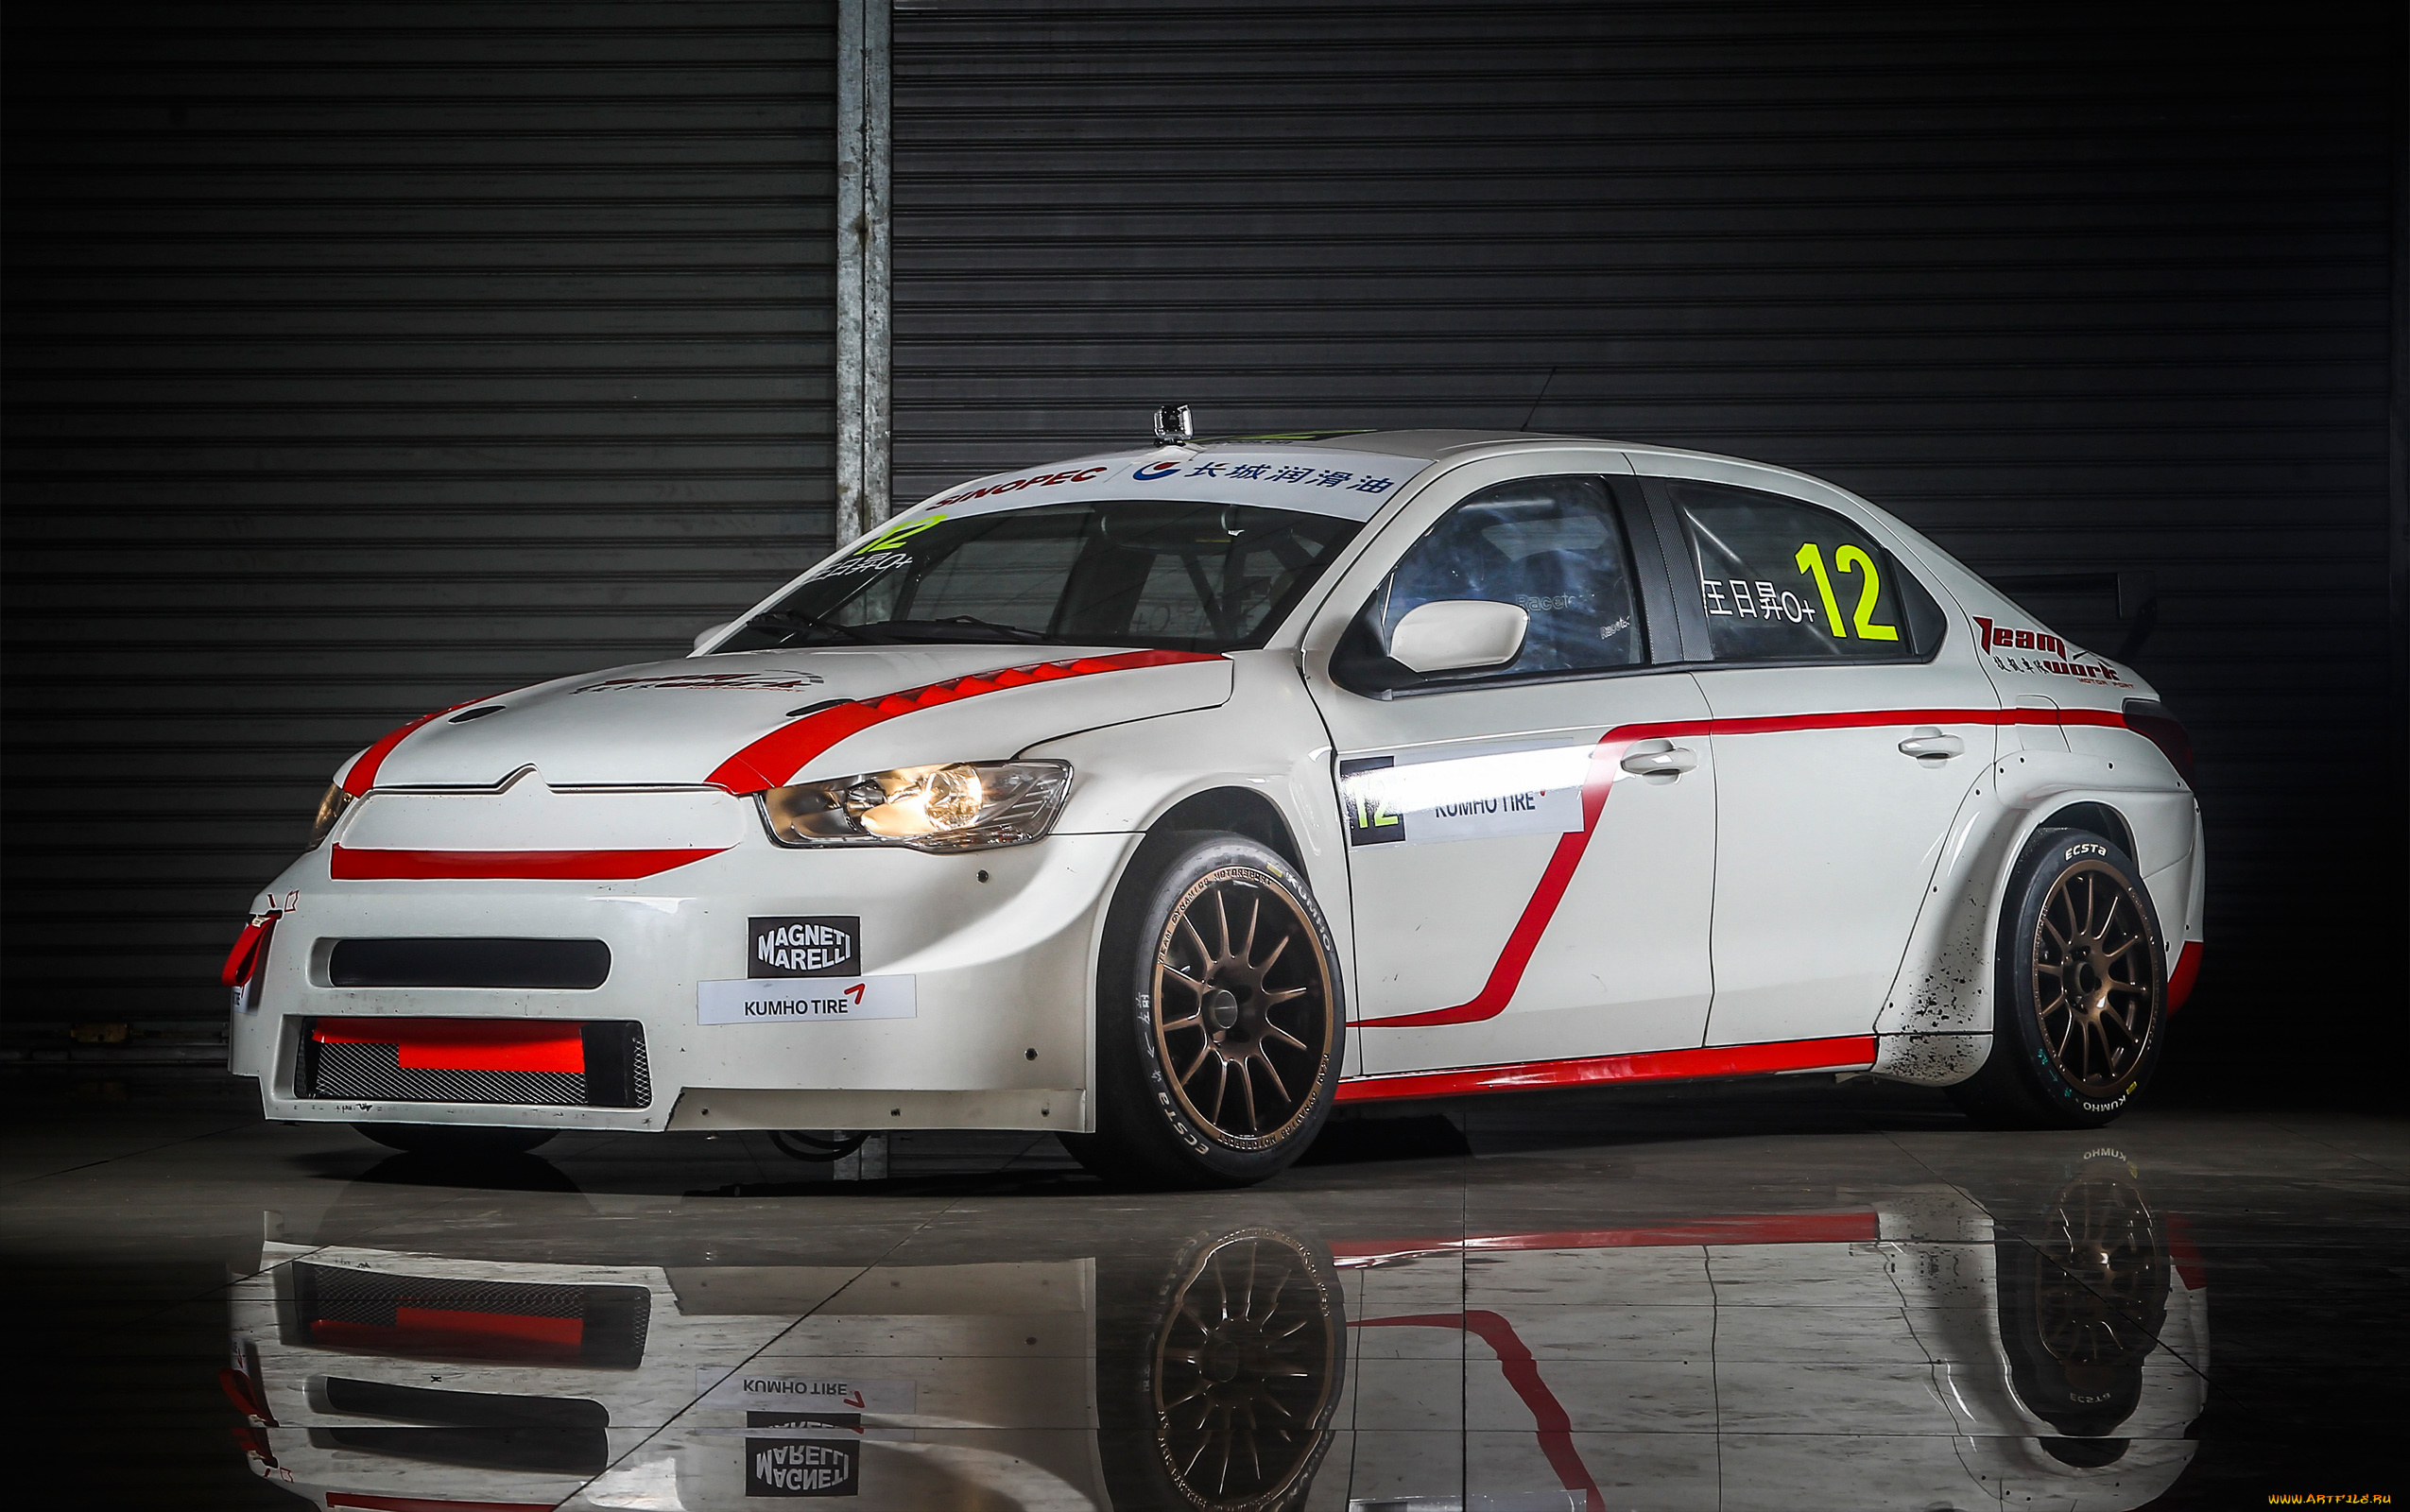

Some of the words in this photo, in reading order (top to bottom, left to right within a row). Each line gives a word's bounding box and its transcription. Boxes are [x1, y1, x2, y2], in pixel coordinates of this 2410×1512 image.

[925, 467, 1108, 511] SINOPEC
[1184, 461, 1395, 494] 长城润滑油
[852, 514, 948, 556] 12
[1795, 542, 1900, 642] 12
[1971, 615, 2068, 662] Team
[2042, 660, 2121, 681] work
[758, 924, 852, 951] MAGNETI
[758, 943, 852, 971] MARELLI
[744, 1000, 808, 1017] KUMHO
[811, 998, 849, 1015] TIRE
[2083, 1095, 2126, 1112] KUMHO
